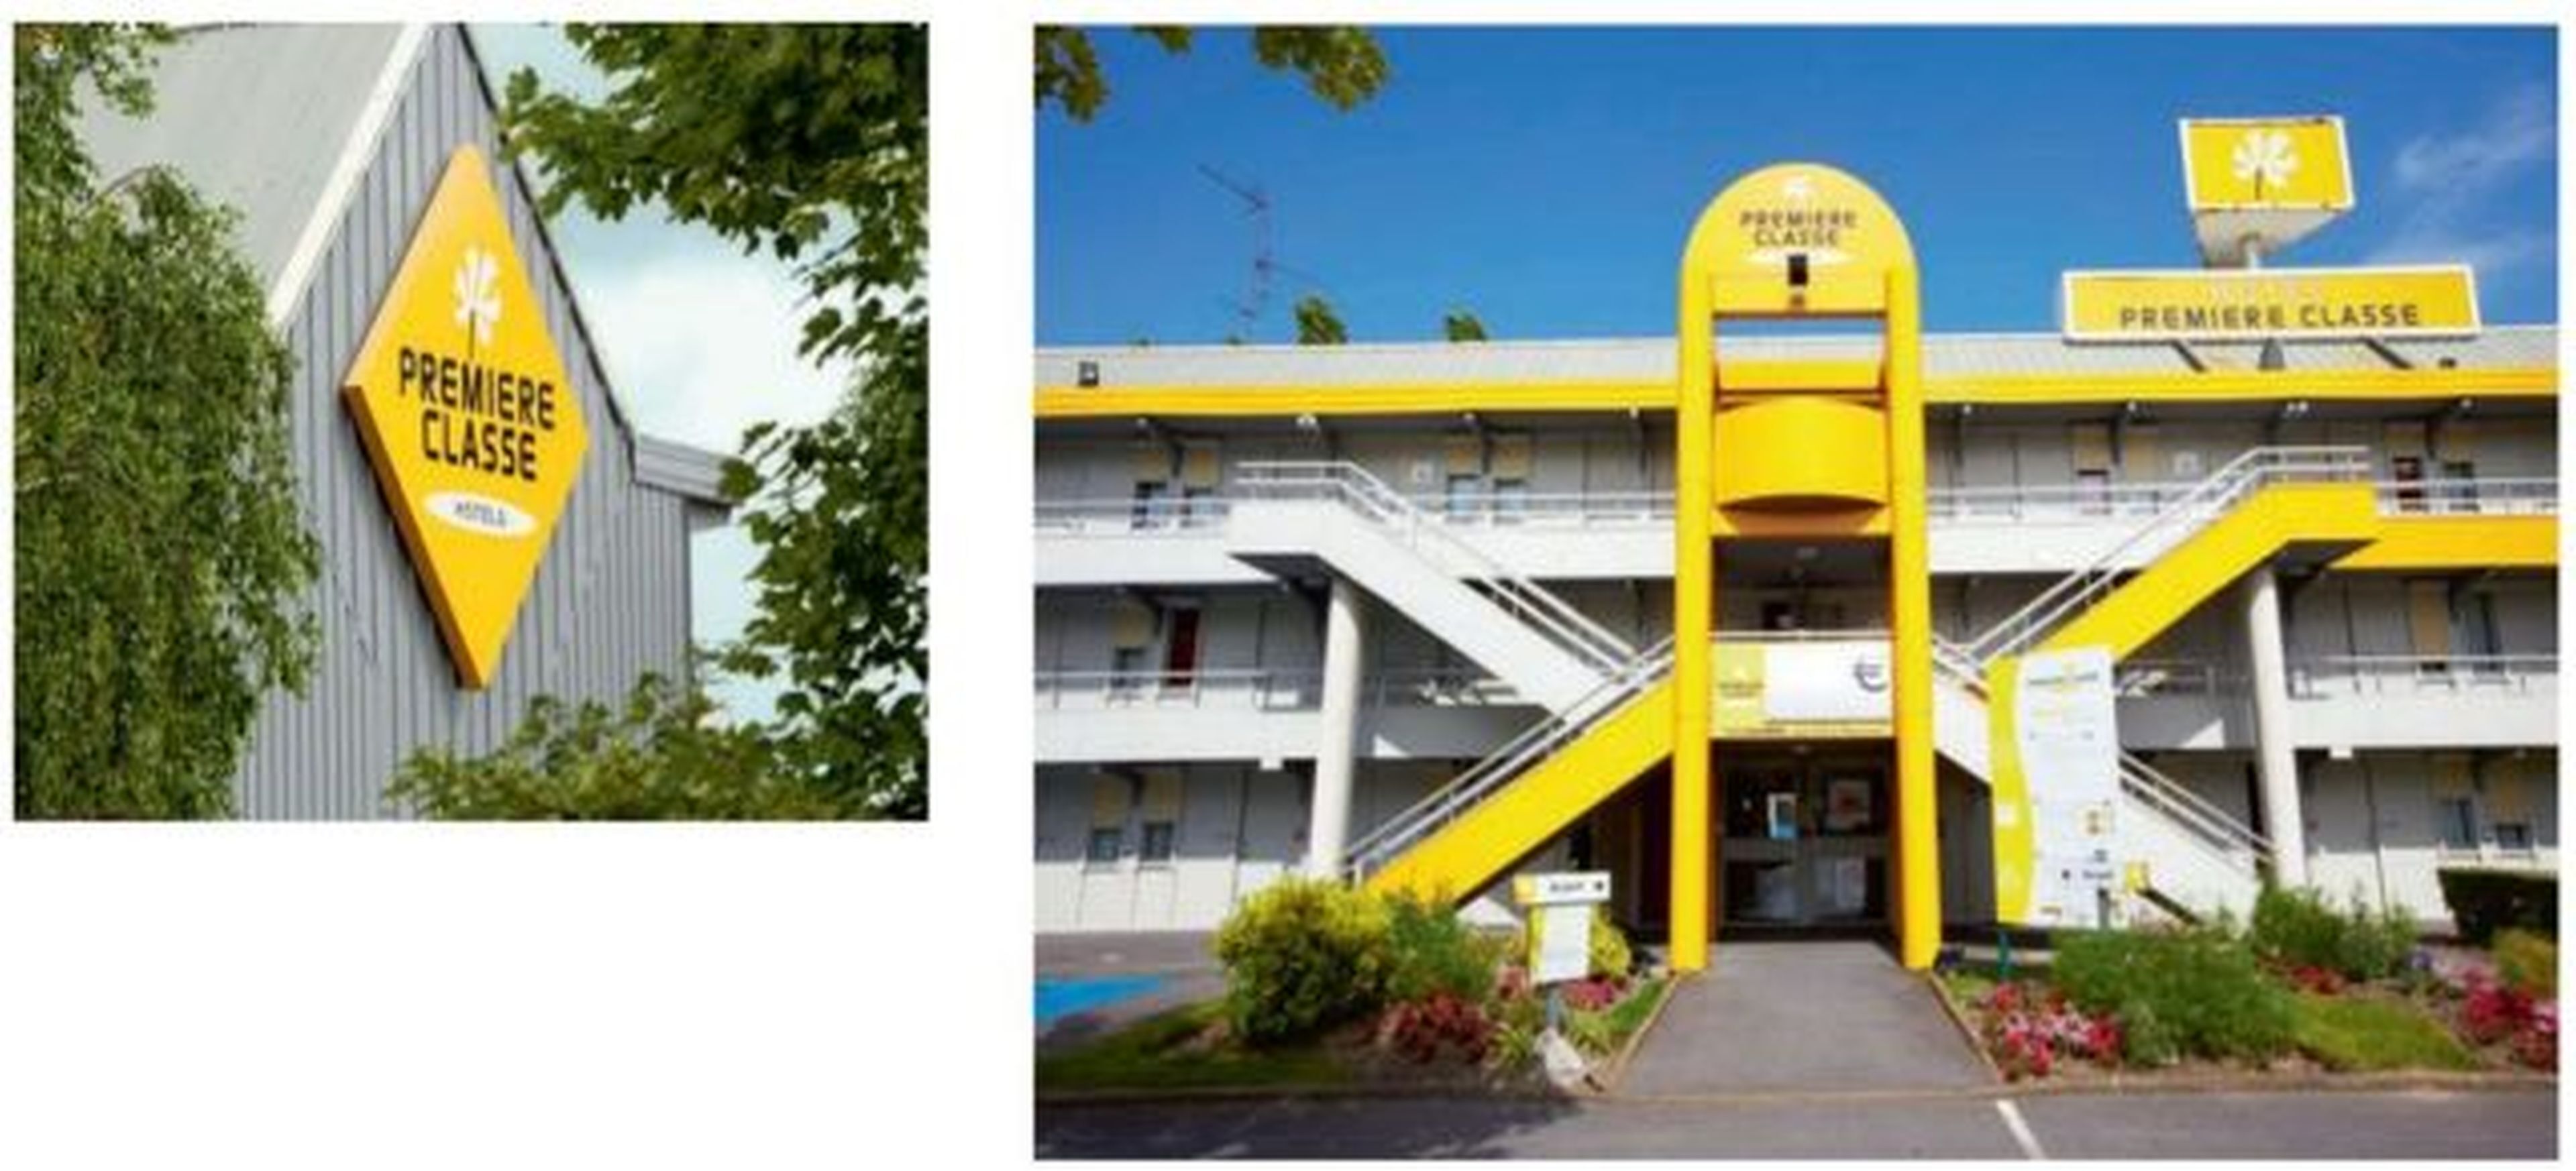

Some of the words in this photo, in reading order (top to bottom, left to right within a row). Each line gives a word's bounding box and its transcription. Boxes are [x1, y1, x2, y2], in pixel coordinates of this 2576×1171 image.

[1739, 209, 1858, 228] PREMIERE
[1754, 229, 1839, 247] CLASSE
[2120, 305, 2284, 330] PREMIERE
[2299, 303, 2419, 327] CLASSE
[399, 346, 554, 431] PREMIERE
[422, 408, 535, 482] CLASSE
